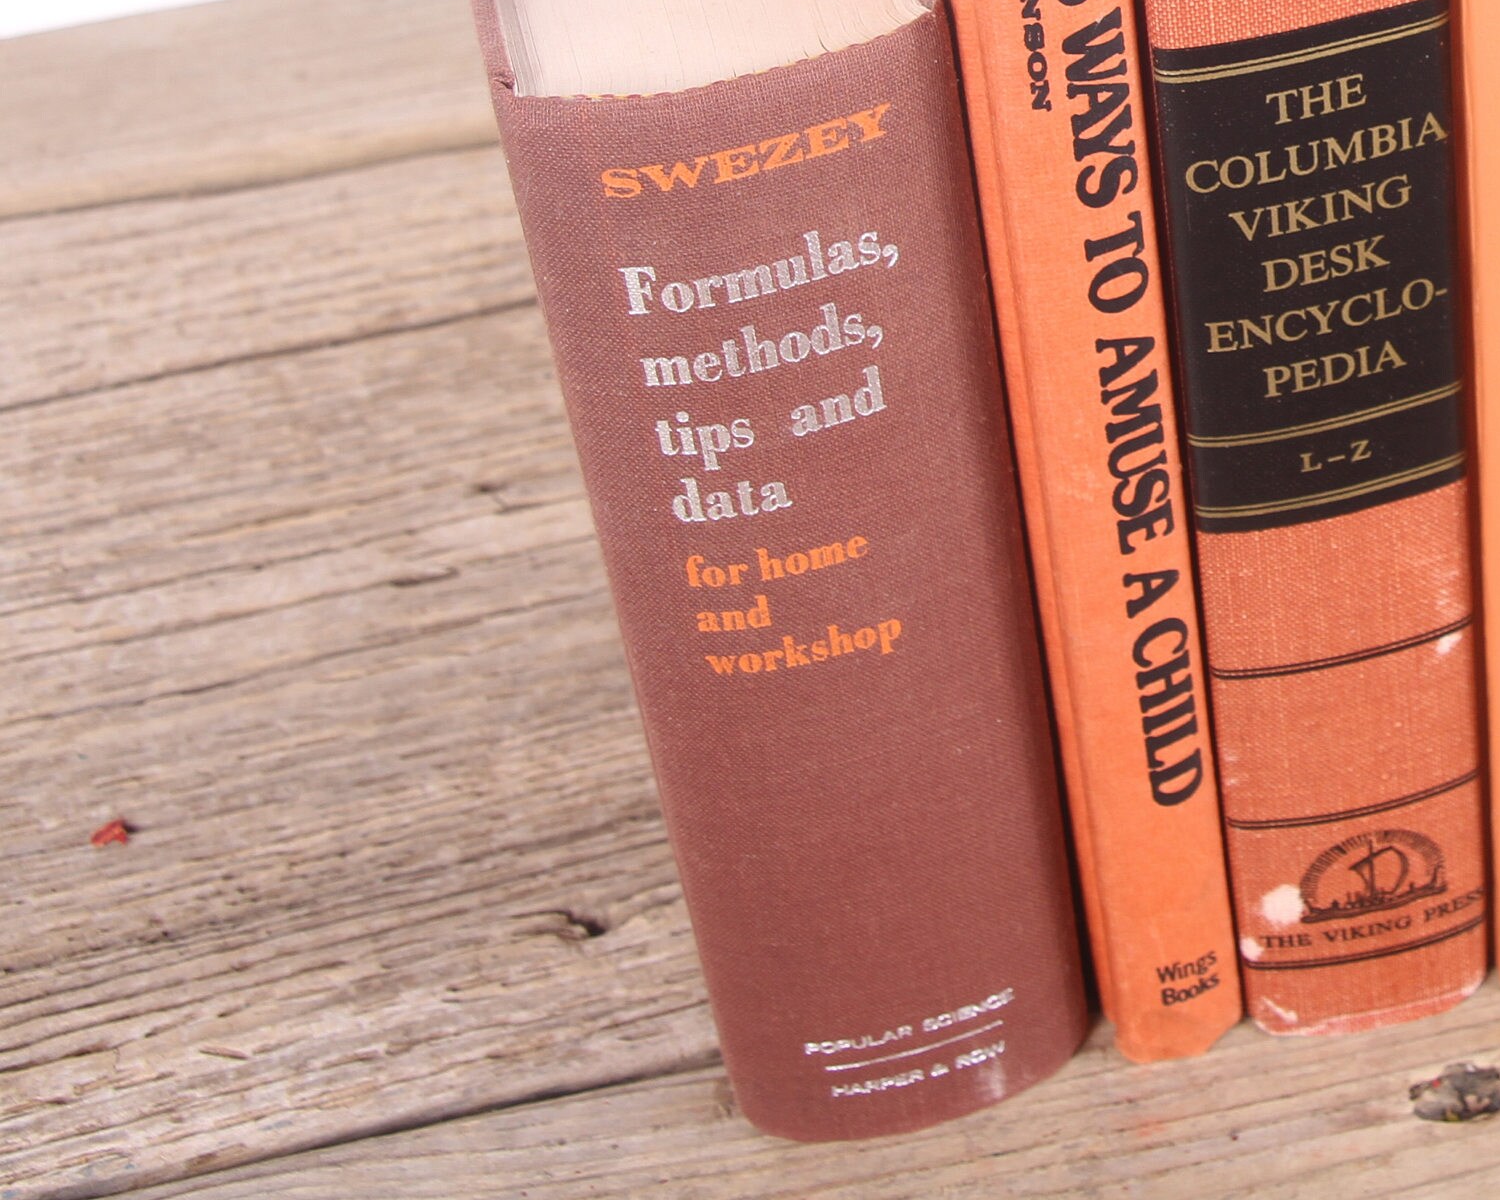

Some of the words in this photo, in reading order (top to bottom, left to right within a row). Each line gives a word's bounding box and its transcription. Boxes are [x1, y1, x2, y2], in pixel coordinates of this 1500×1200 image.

[1061, 6, 1139, 209] WAYS
[1266, 73, 1367, 125] THE
[602, 102, 892, 199] SWEZEY
[1185, 111, 1449, 193] COLUMBIA
[1229, 174, 1412, 242] VIKING
[618, 230, 900, 316] Formulas,
[1083, 211, 1150, 315] TO
[1261, 234, 1391, 293] DESK
[640, 302, 884, 387] methods,
[1205, 277, 1449, 354] ENCYCLO-
[1262, 340, 1407, 399] PEDIA
[654, 411, 754, 471] tips
[791, 365, 888, 438] and
[1095, 336, 1175, 556] AMUSE
[671, 478, 794, 523] data
[685, 554, 749, 588] for
[755, 533, 869, 581] home
[696, 595, 772, 633] and
[1122, 567, 1180, 620] A
[705, 617, 903, 678] workshop
[1131, 616, 1204, 809] CHILD
[1261, 934, 1312, 949] THE
[1322, 917, 1412, 943] VIKING
[1423, 887, 1483, 923] PRESS
[1157, 952, 1217, 983] Wings
[1161, 974, 1220, 1006] Books
[804, 1025, 913, 1055] POPULAR
[922, 987, 1015, 1031] SCIENCE
[831, 1069, 925, 1097] HARPER
[955, 1040, 1005, 1070] ROW
